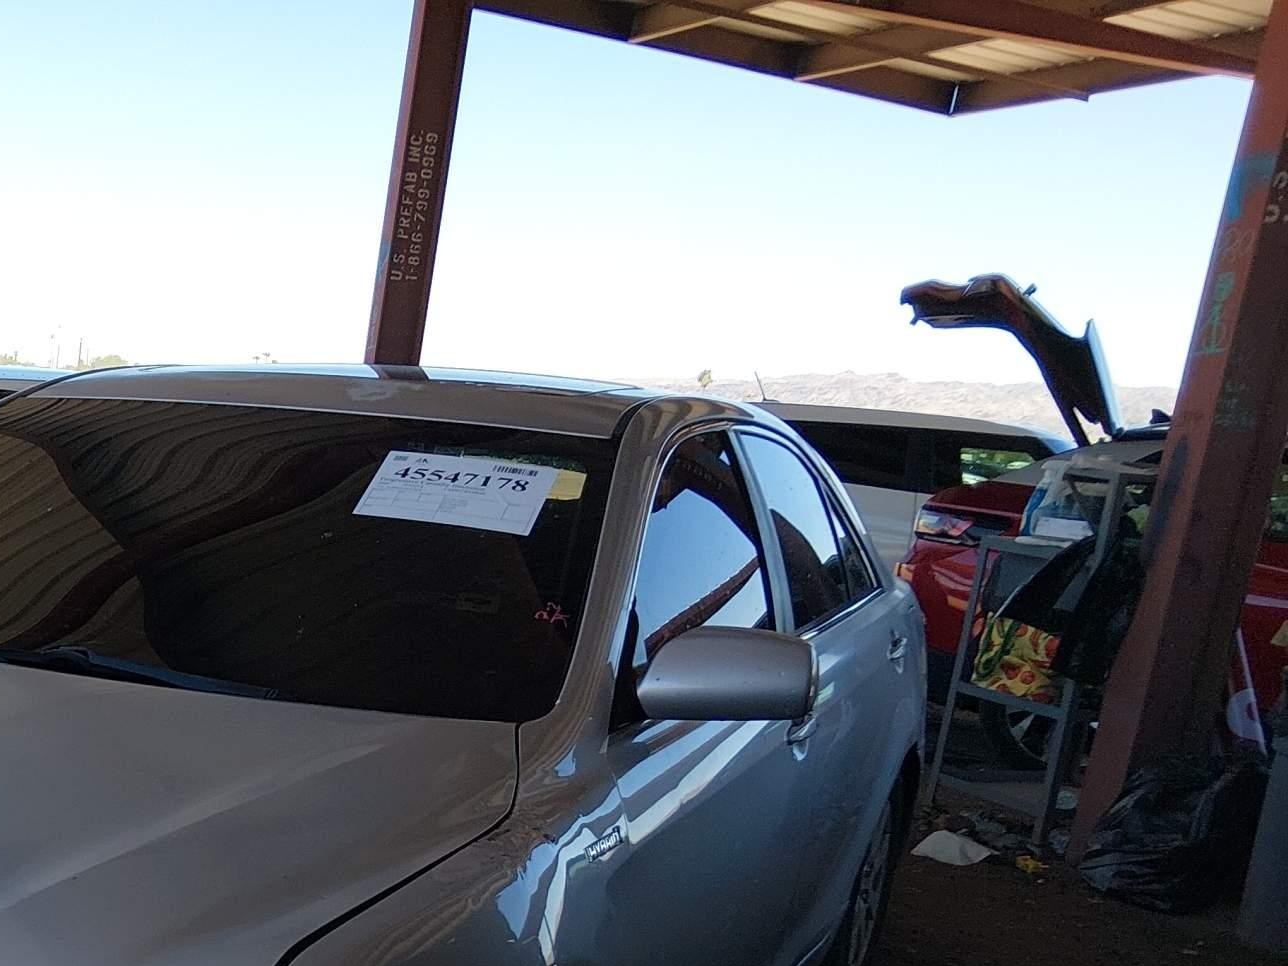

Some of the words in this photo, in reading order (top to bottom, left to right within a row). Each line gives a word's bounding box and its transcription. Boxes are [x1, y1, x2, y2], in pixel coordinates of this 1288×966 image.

[408, 130, 425, 163] INC.
[398, 172, 418, 239] PREFAB
[406, 132, 439, 281] 1-866-799-0969
[390, 249, 407, 281] U.S.
[394, 466, 530, 493] 45547178
[588, 831, 620, 856] HYBRID
